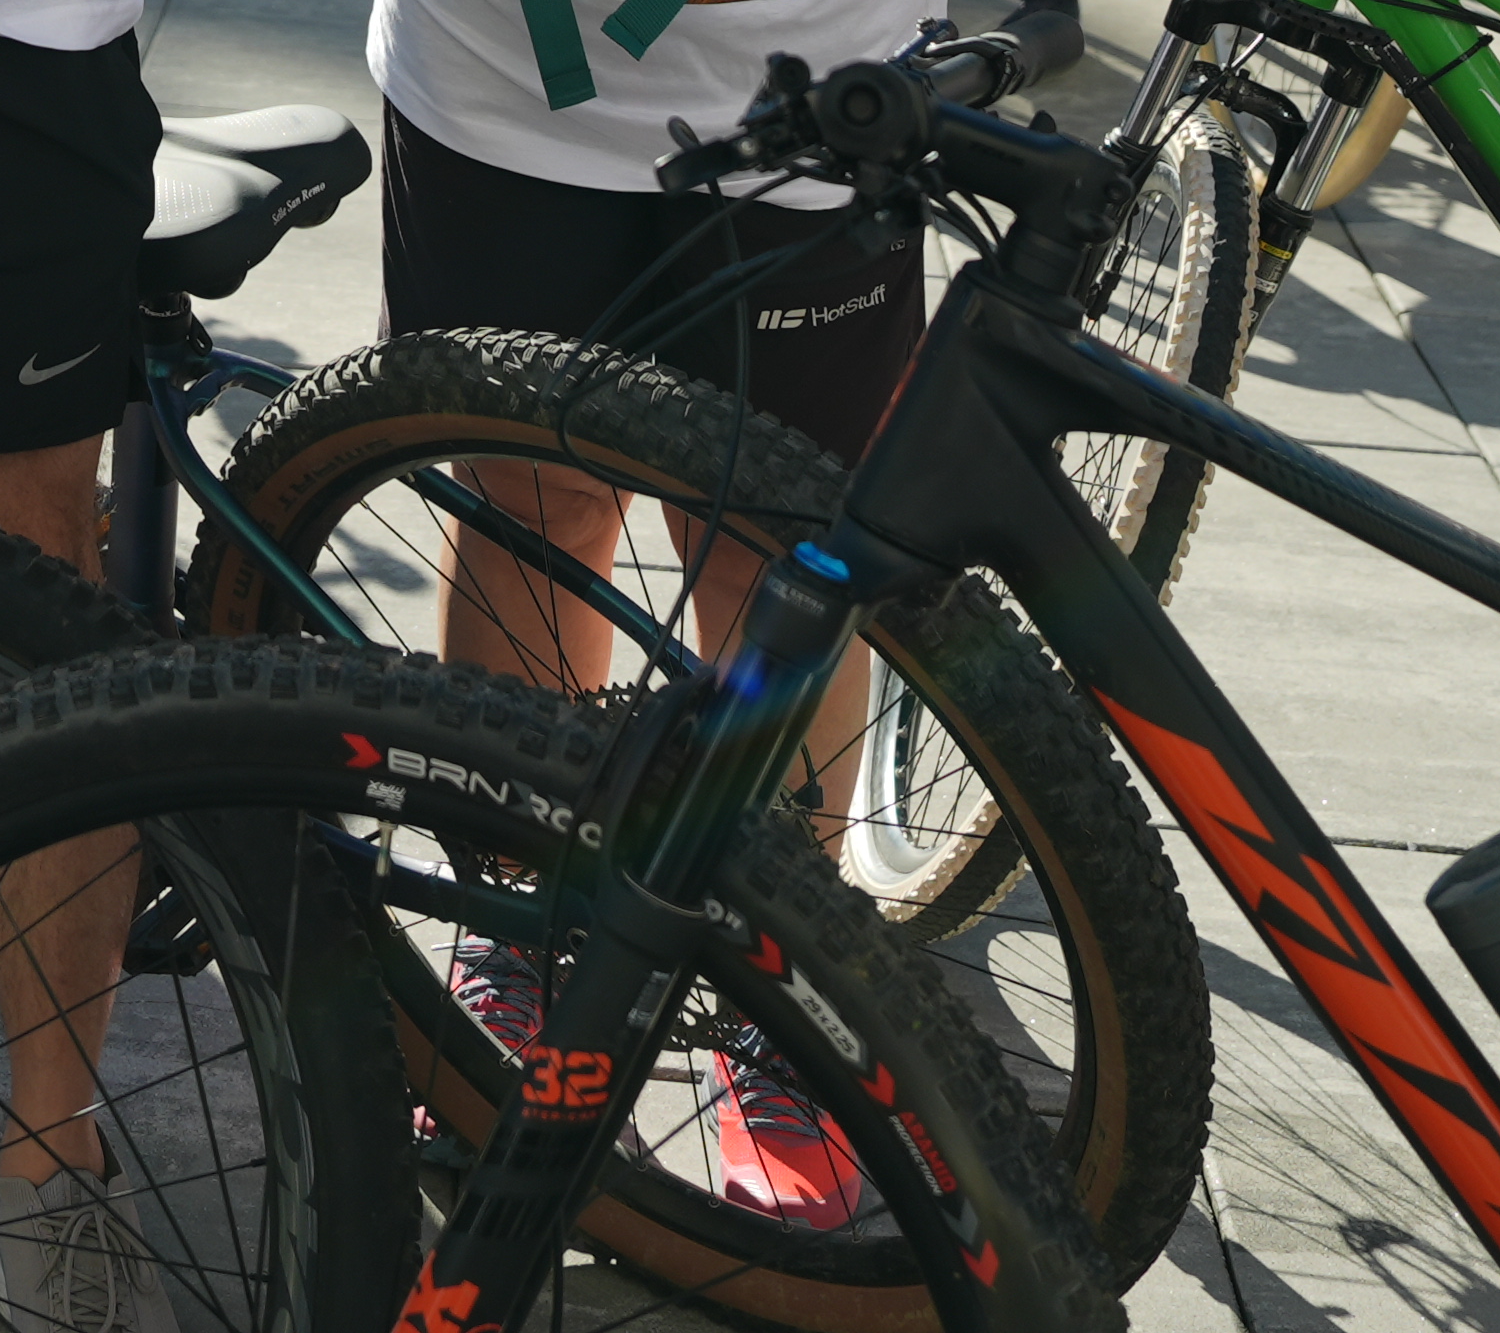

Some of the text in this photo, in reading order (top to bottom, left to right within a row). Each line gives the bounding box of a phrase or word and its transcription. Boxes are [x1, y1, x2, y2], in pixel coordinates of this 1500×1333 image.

[286, 195, 301, 213] San
[301, 181, 326, 203] Remo
[811, 283, 886, 327] HotStuff
[387, 746, 510, 806] BRN
[802, 995, 821, 1014] 29
[521, 1044, 614, 1108] 32
